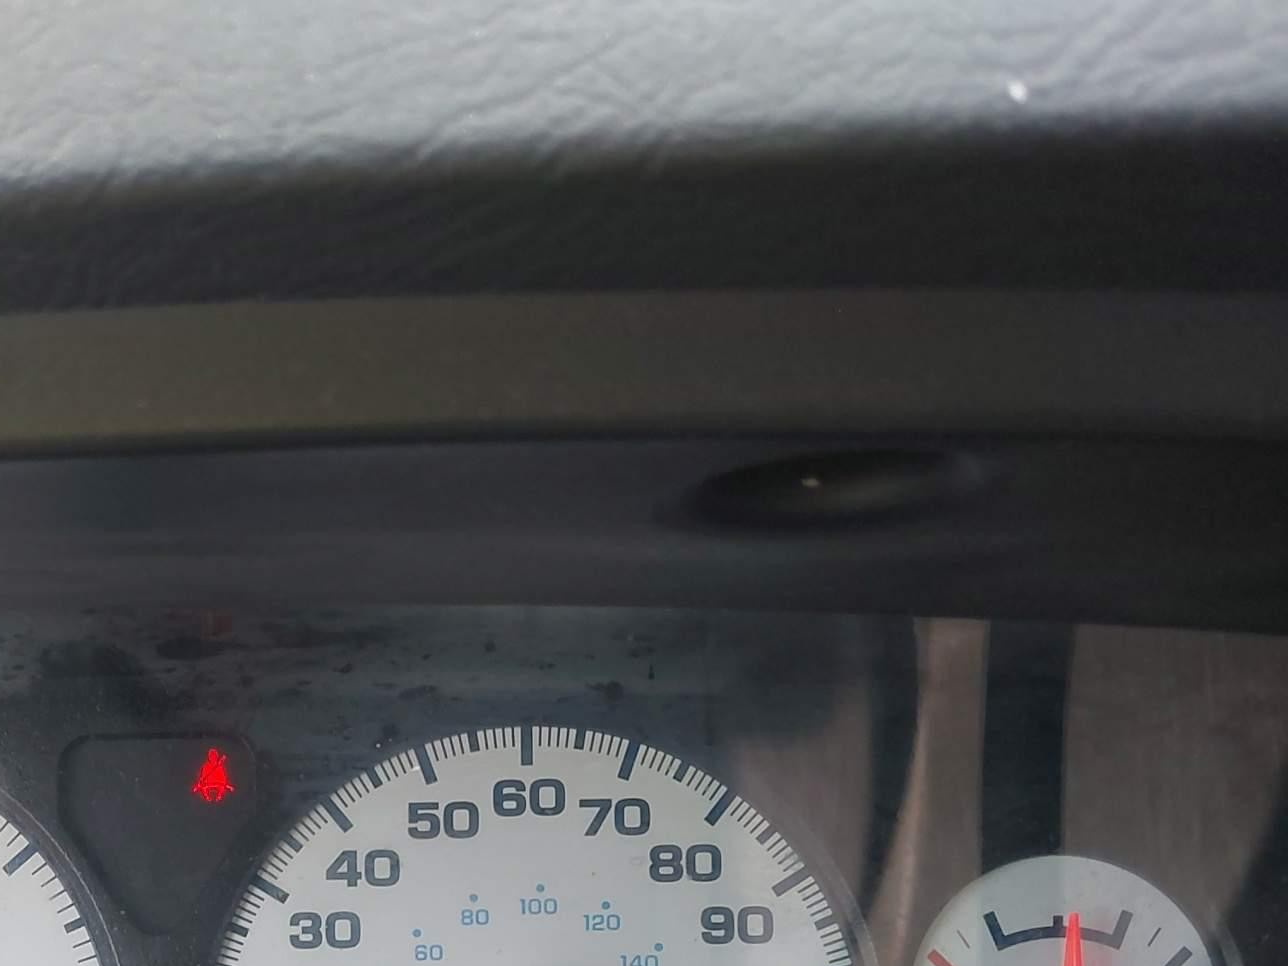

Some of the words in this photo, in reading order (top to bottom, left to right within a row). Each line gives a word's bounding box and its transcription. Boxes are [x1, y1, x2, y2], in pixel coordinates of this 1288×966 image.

[493, 779, 566, 816] 60
[407, 802, 479, 838] 50
[579, 798, 650, 836] 70
[327, 850, 401, 886] 40
[649, 844, 722, 882] 80
[461, 908, 489, 926] 80
[519, 897, 558, 915] 100
[583, 913, 621, 932] 120
[289, 912, 361, 949] 30
[699, 906, 773, 944] 90
[415, 944, 444, 962] 60
